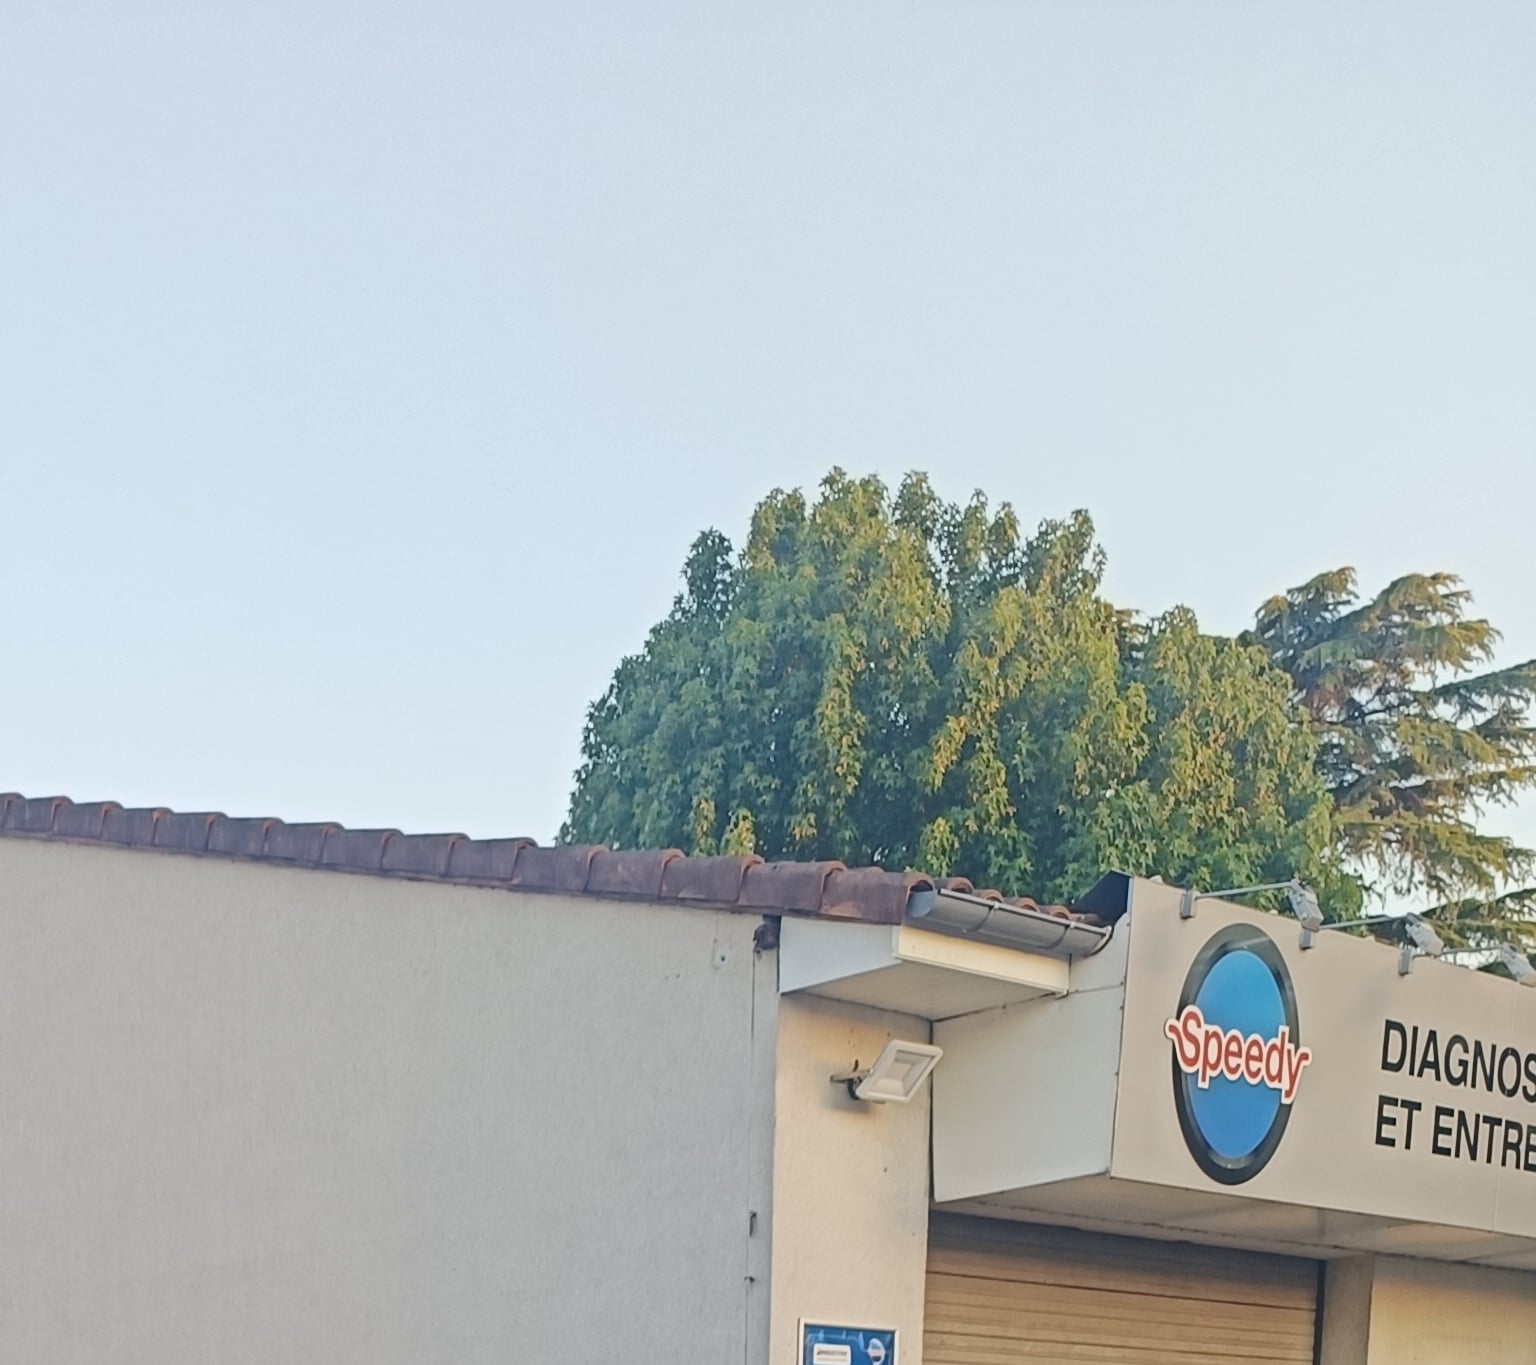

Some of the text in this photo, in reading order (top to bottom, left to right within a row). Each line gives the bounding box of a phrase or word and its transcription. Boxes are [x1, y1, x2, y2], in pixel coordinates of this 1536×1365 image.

[1166, 1008, 1311, 1101] Speedy
[1375, 1094, 1536, 1173] ET ENTRE
